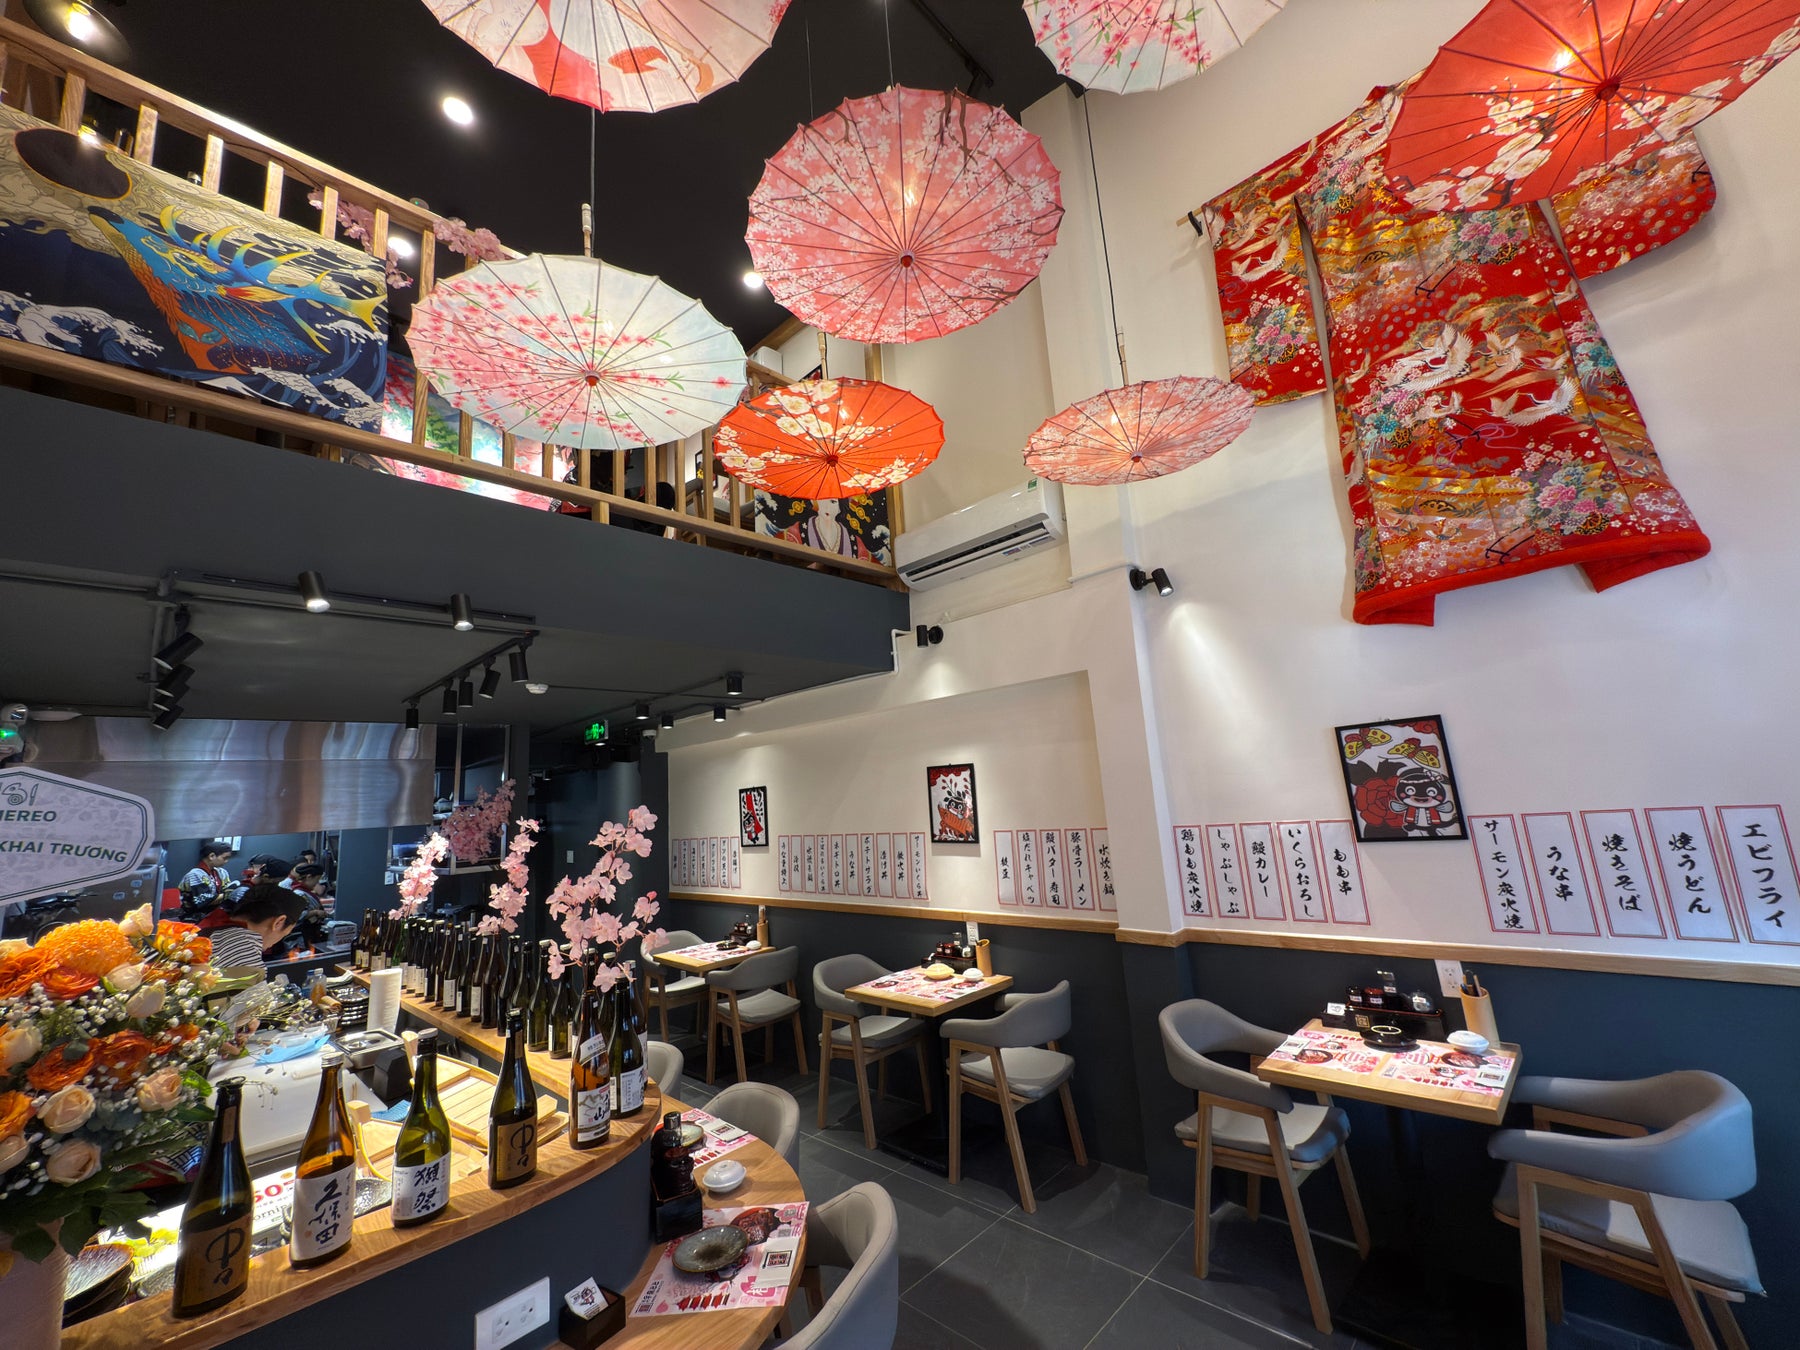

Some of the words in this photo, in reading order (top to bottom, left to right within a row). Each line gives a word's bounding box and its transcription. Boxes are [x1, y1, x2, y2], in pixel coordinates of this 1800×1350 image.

[0, 840, 44, 853] KHAI
[51, 842, 128, 863] TRƯƠNG
[1217, 829, 1240, 913] しゃぶしゃぶ
[1287, 828, 1314, 918] いくらおろし
[1601, 833, 1643, 912] 焼きそば
[1668, 832, 1711, 914] 焼うどん
[308, 1178, 343, 1244] 久保田
